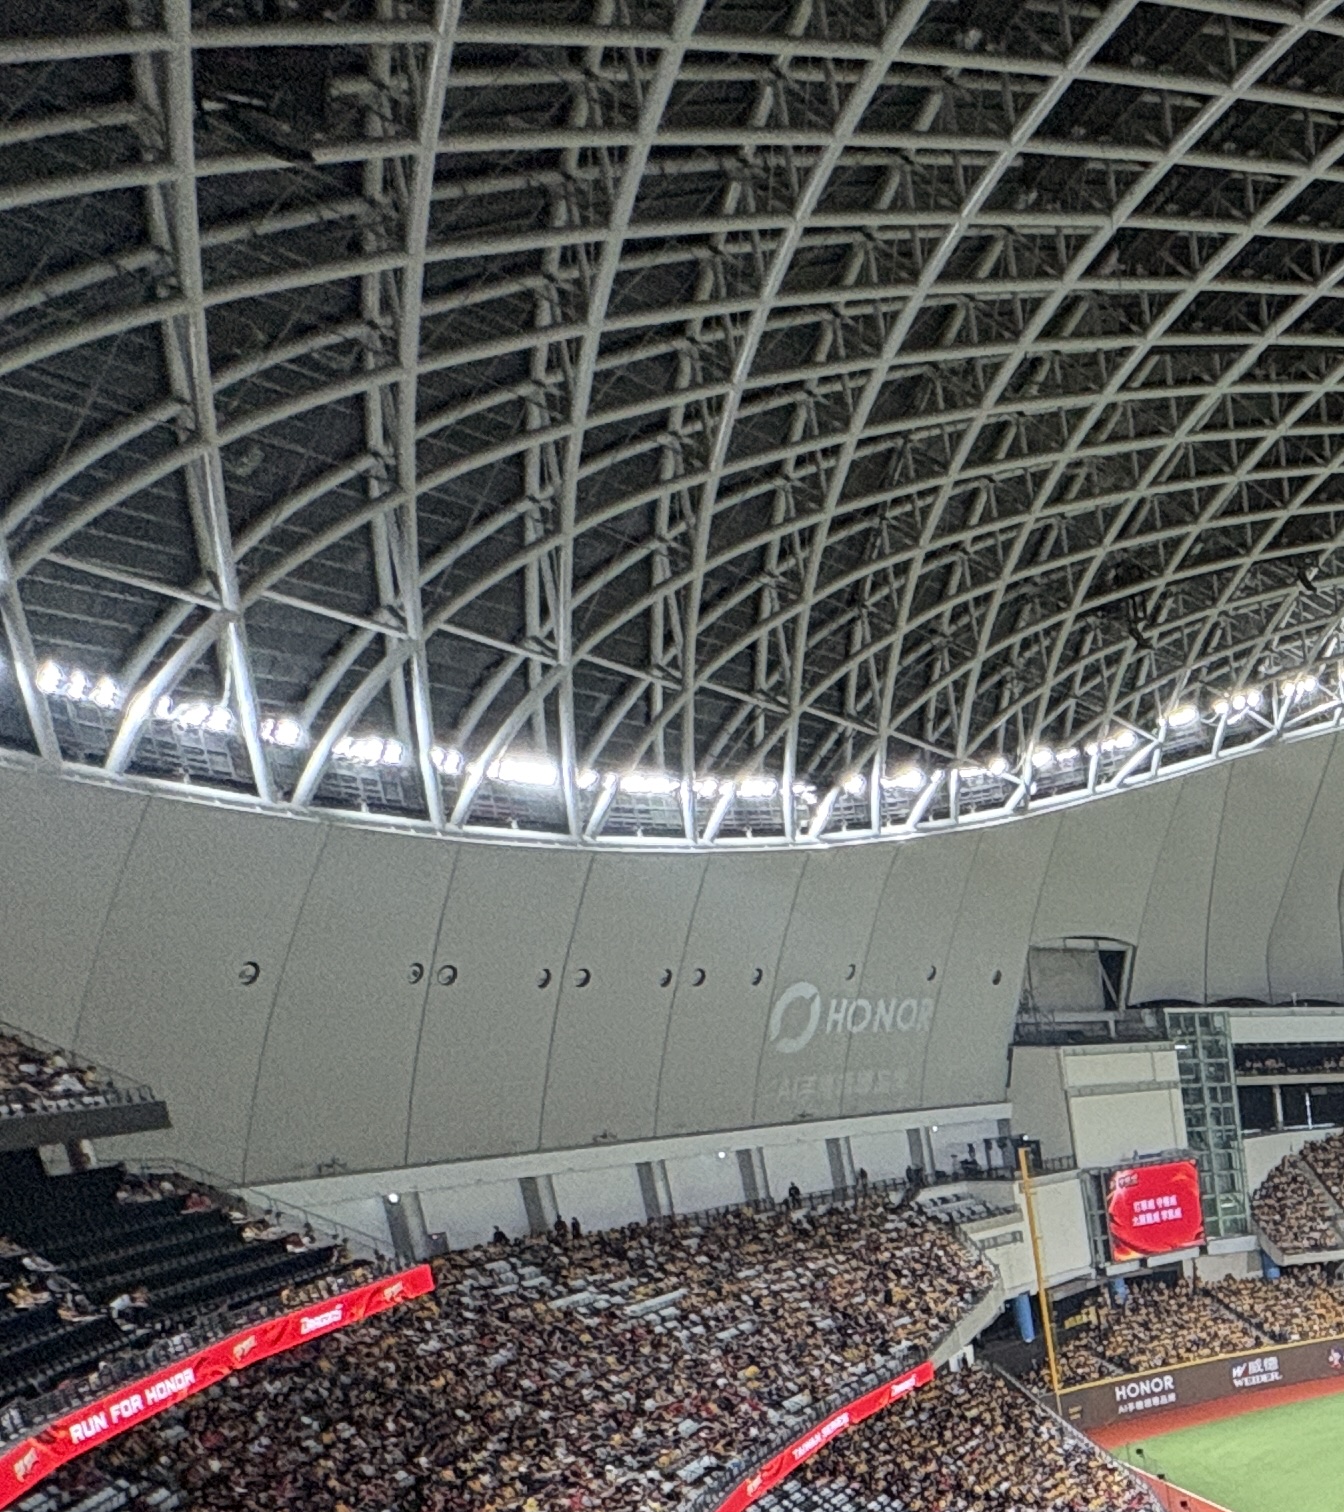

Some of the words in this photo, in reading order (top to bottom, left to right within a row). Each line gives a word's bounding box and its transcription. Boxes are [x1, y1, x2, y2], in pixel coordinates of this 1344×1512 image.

[826, 998, 935, 1035] HONOR
[69, 1409, 107, 1444] RUN
[110, 1394, 143, 1424] FOR
[146, 1367, 195, 1407] HONOR
[1115, 1375, 1175, 1402] HONOR
